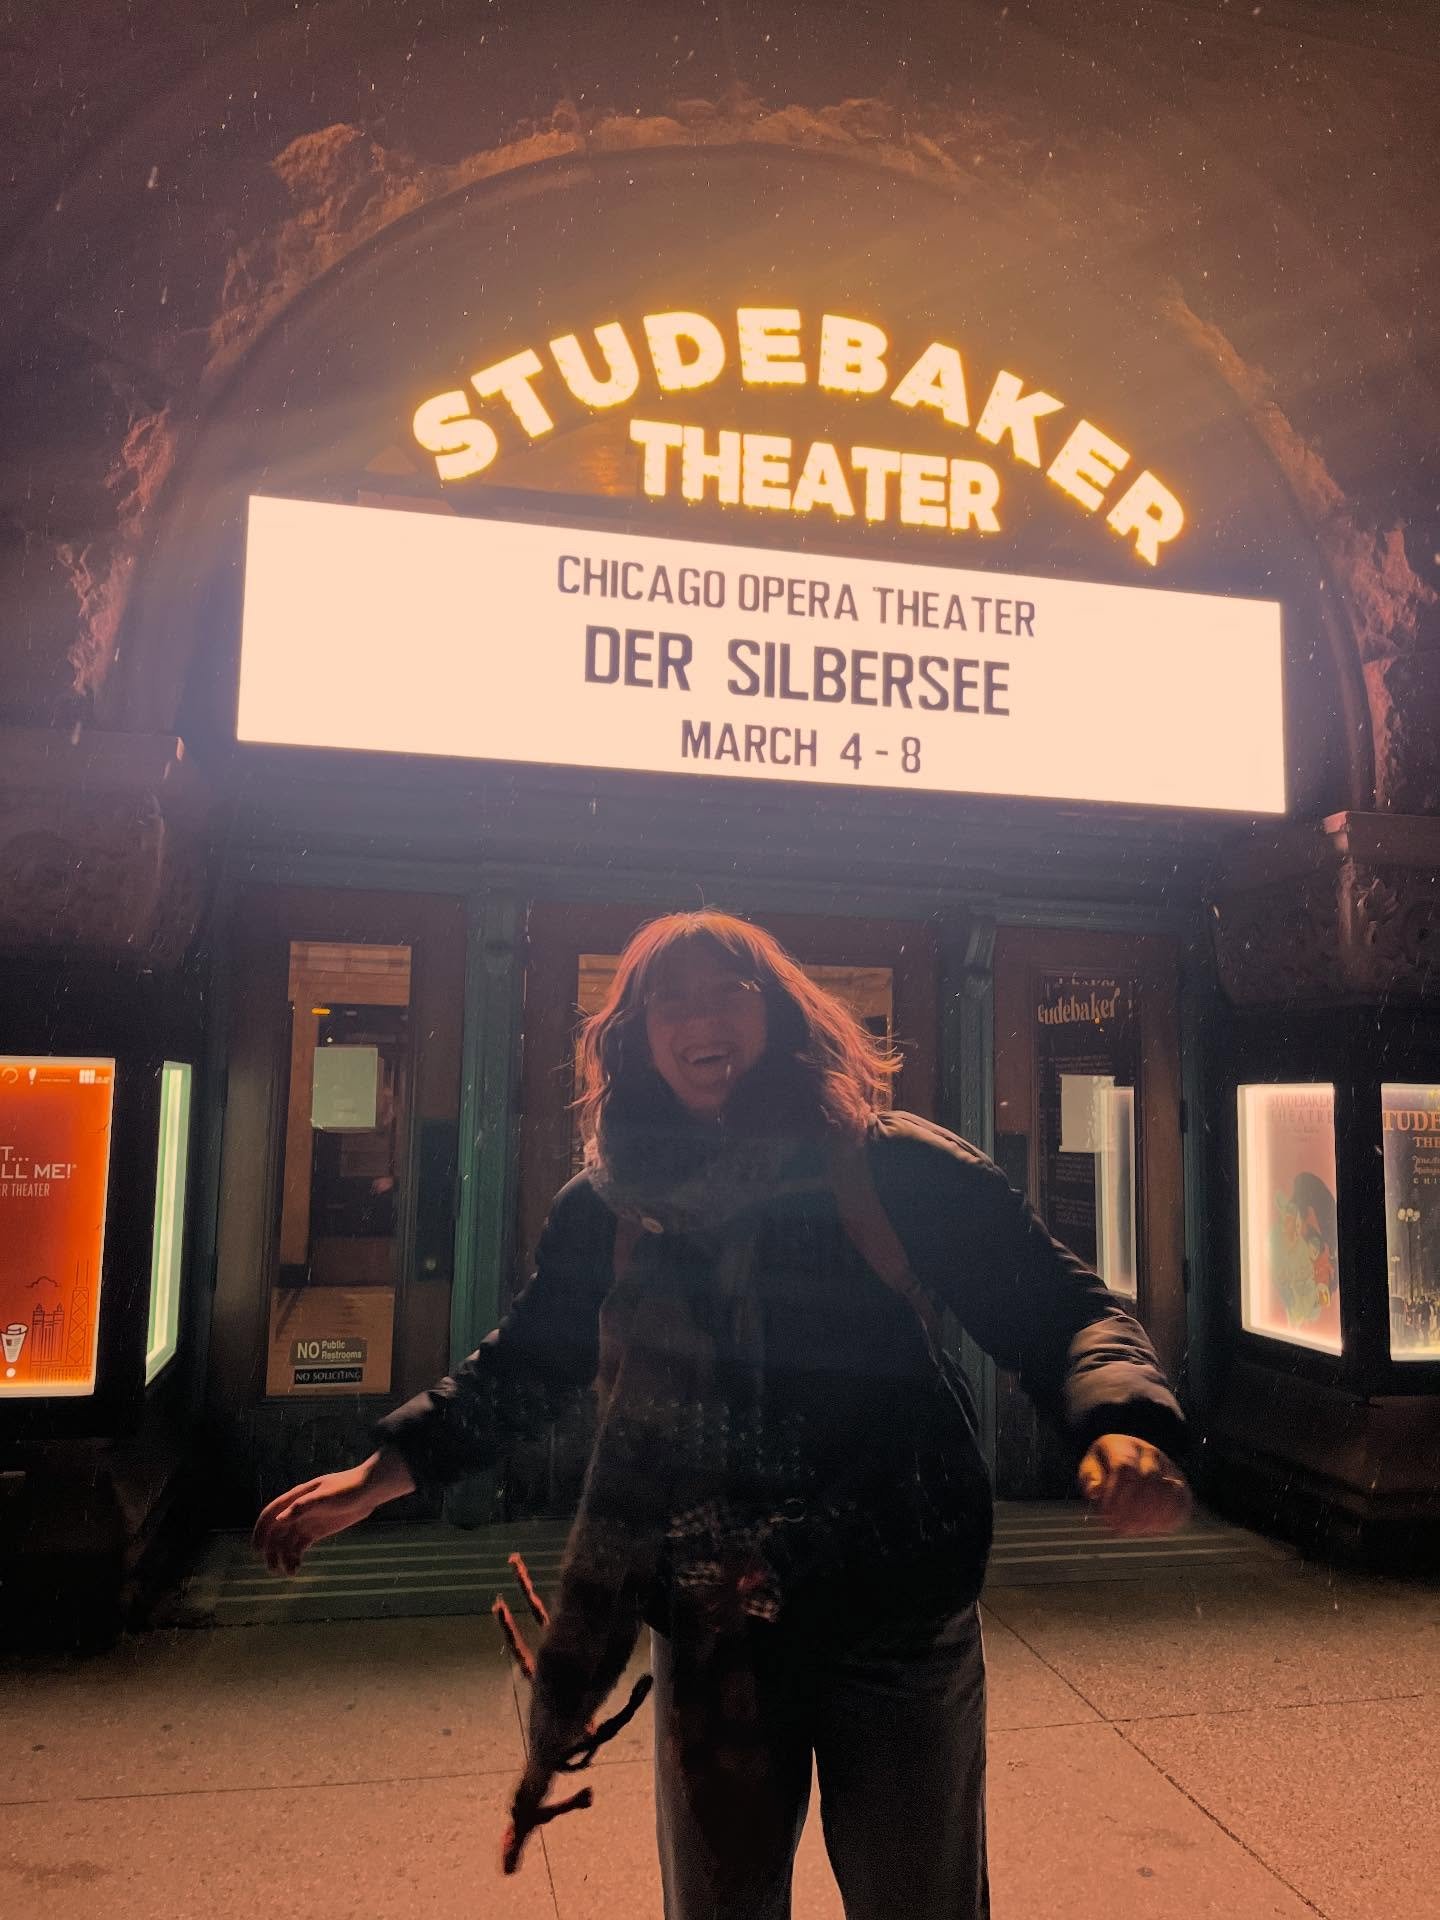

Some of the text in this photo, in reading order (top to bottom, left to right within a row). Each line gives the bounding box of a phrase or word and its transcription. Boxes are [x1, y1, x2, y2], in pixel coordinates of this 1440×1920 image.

[411, 306, 1185, 566] STUDEBAKER
[629, 419, 1001, 533] THEATER
[556, 555, 1036, 638] CHICAGO OPERA THEATER
[584, 624, 1011, 717] DER SILBERSEE
[681, 719, 818, 768] MARCH
[839, 732, 863, 770] 4
[900, 735, 922, 774] 8
[12, 1183, 50, 1197] THEATER
[296, 1371, 361, 1382] NO SOLICITING
[297, 1340, 345, 1359] NO Public
[321, 1351, 362, 1360] Restrooms
